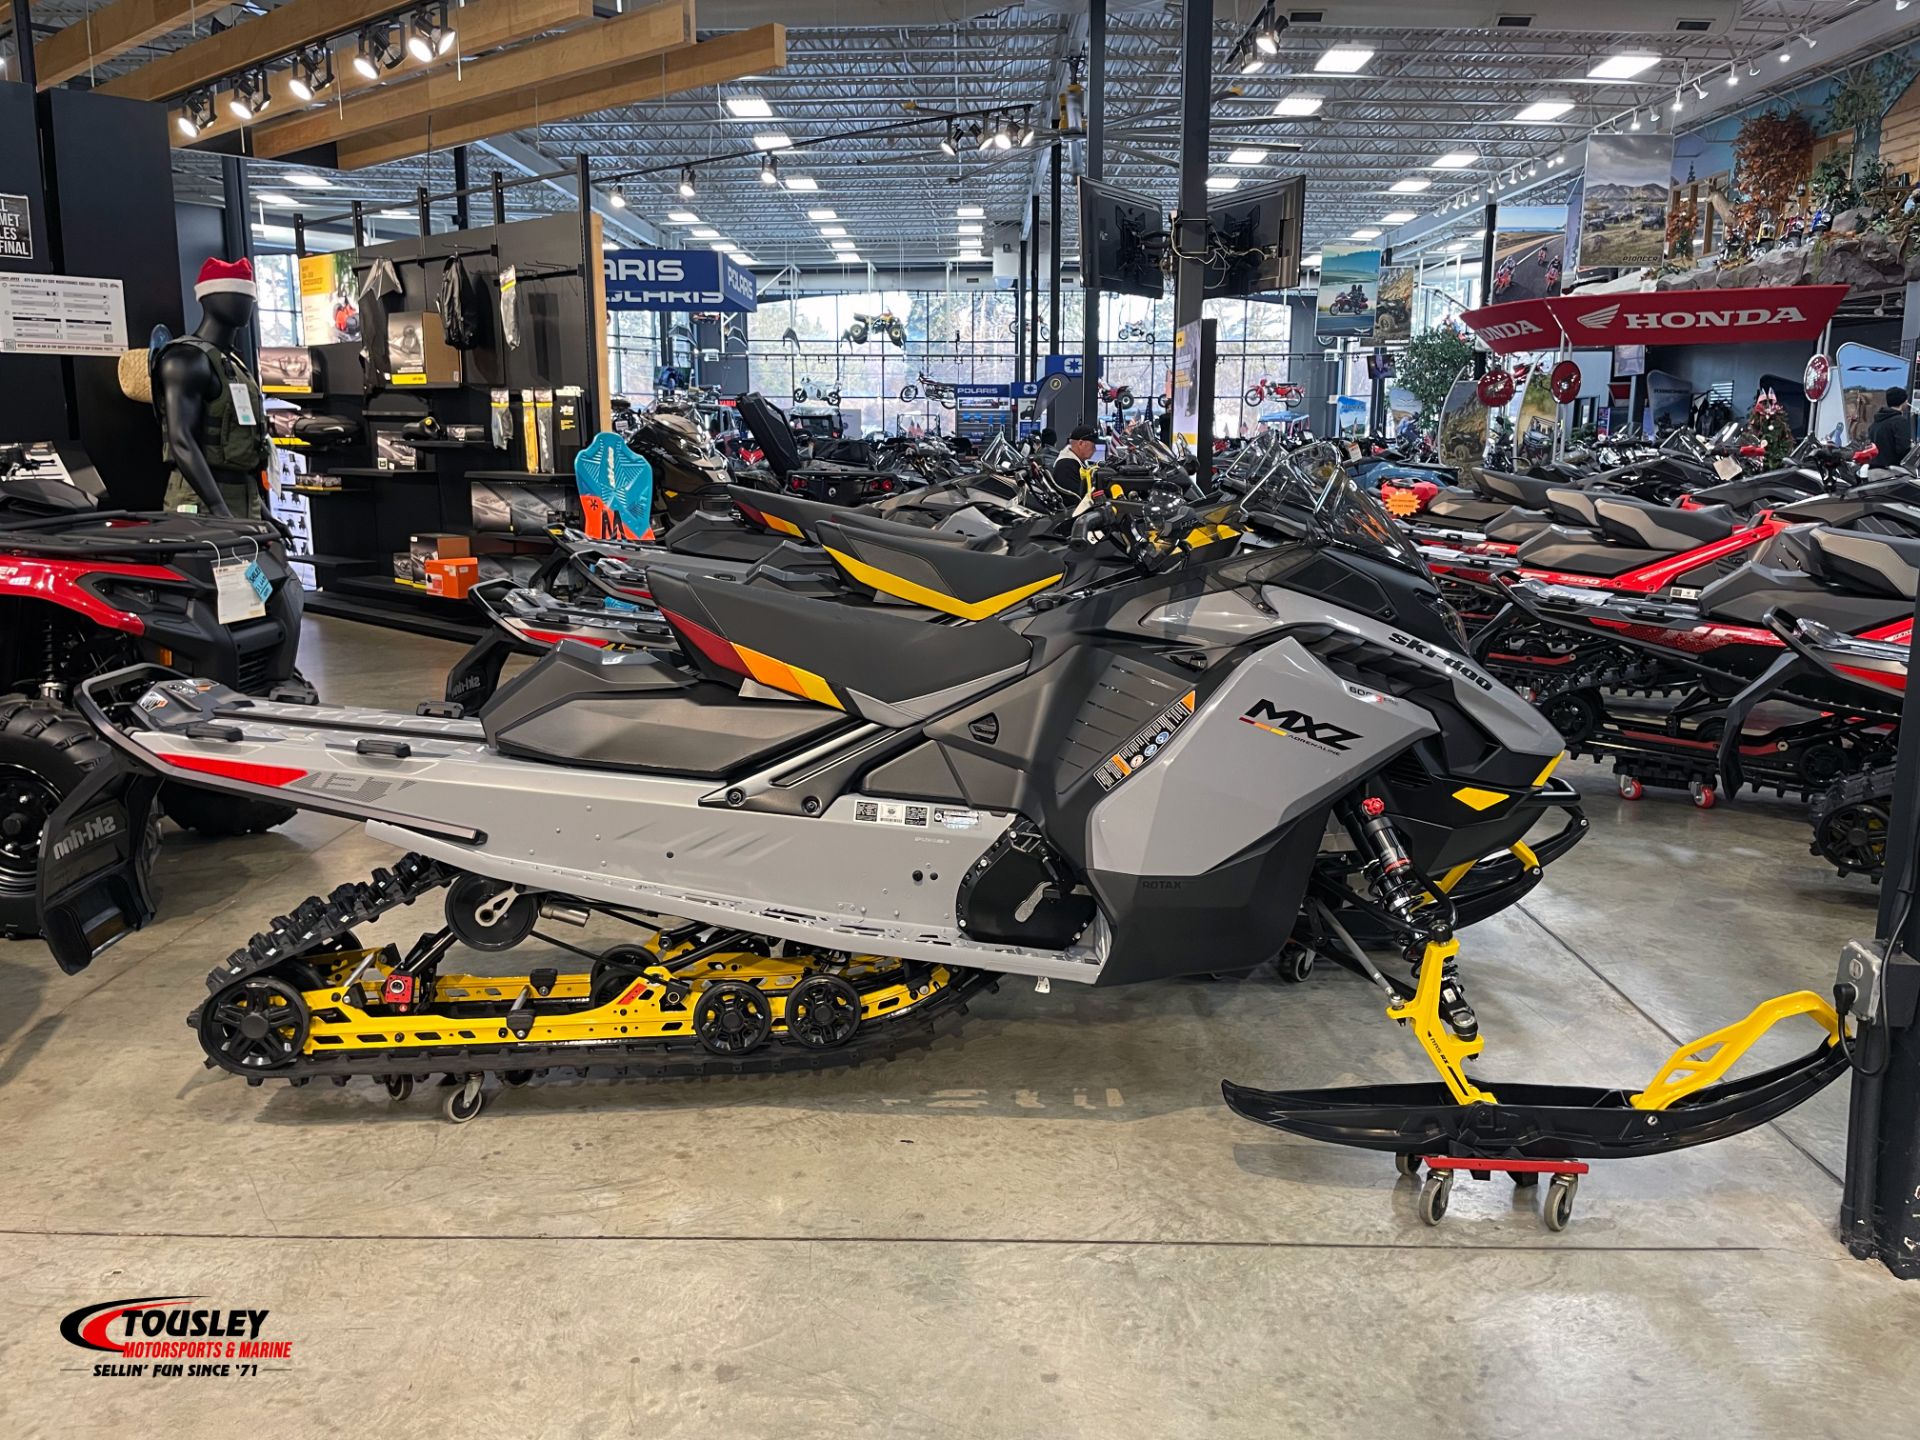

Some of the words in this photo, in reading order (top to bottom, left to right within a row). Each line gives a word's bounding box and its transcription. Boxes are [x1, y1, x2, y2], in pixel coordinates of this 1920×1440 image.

[727, 265, 754, 301] POLARIS
[1623, 306, 1807, 330] HONDA
[957, 387, 998, 395] POLARIS
[1388, 632, 1493, 691] ski-doo
[1243, 698, 1364, 751] MXZ
[1288, 734, 1342, 757] ADRENALINE
[1142, 880, 1183, 890] ROTAX
